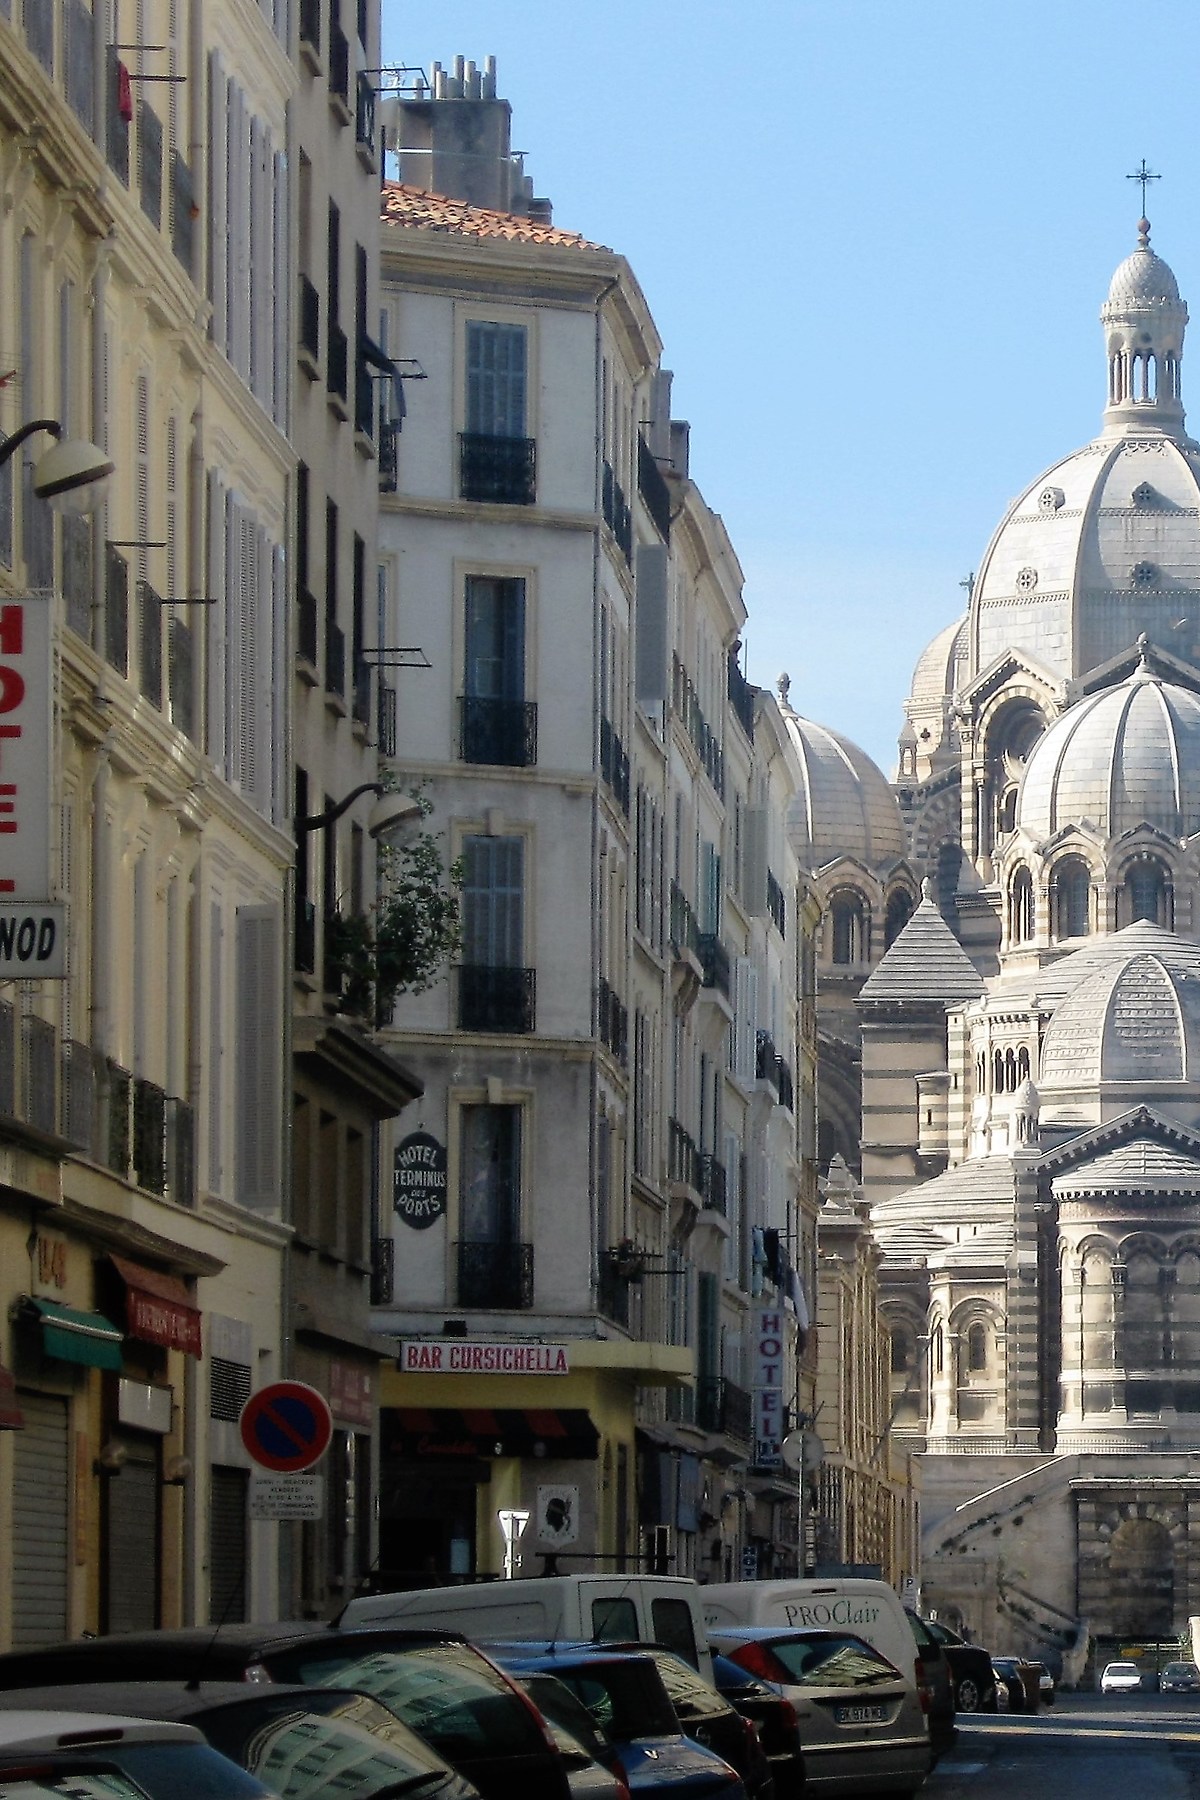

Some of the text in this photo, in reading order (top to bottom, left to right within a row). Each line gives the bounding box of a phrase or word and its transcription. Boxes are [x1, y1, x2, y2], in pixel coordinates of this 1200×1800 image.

[398, 1145, 437, 1168] HOTEL
[393, 1169, 446, 1187] TERMINUS
[396, 1193, 441, 1216] PORTS
[406, 1346, 568, 1371] BAR CURSICHELLA
[759, 1314, 781, 1438] HOTEL
[906, 1578, 914, 1588] P
[784, 1600, 880, 1627] PROClair
